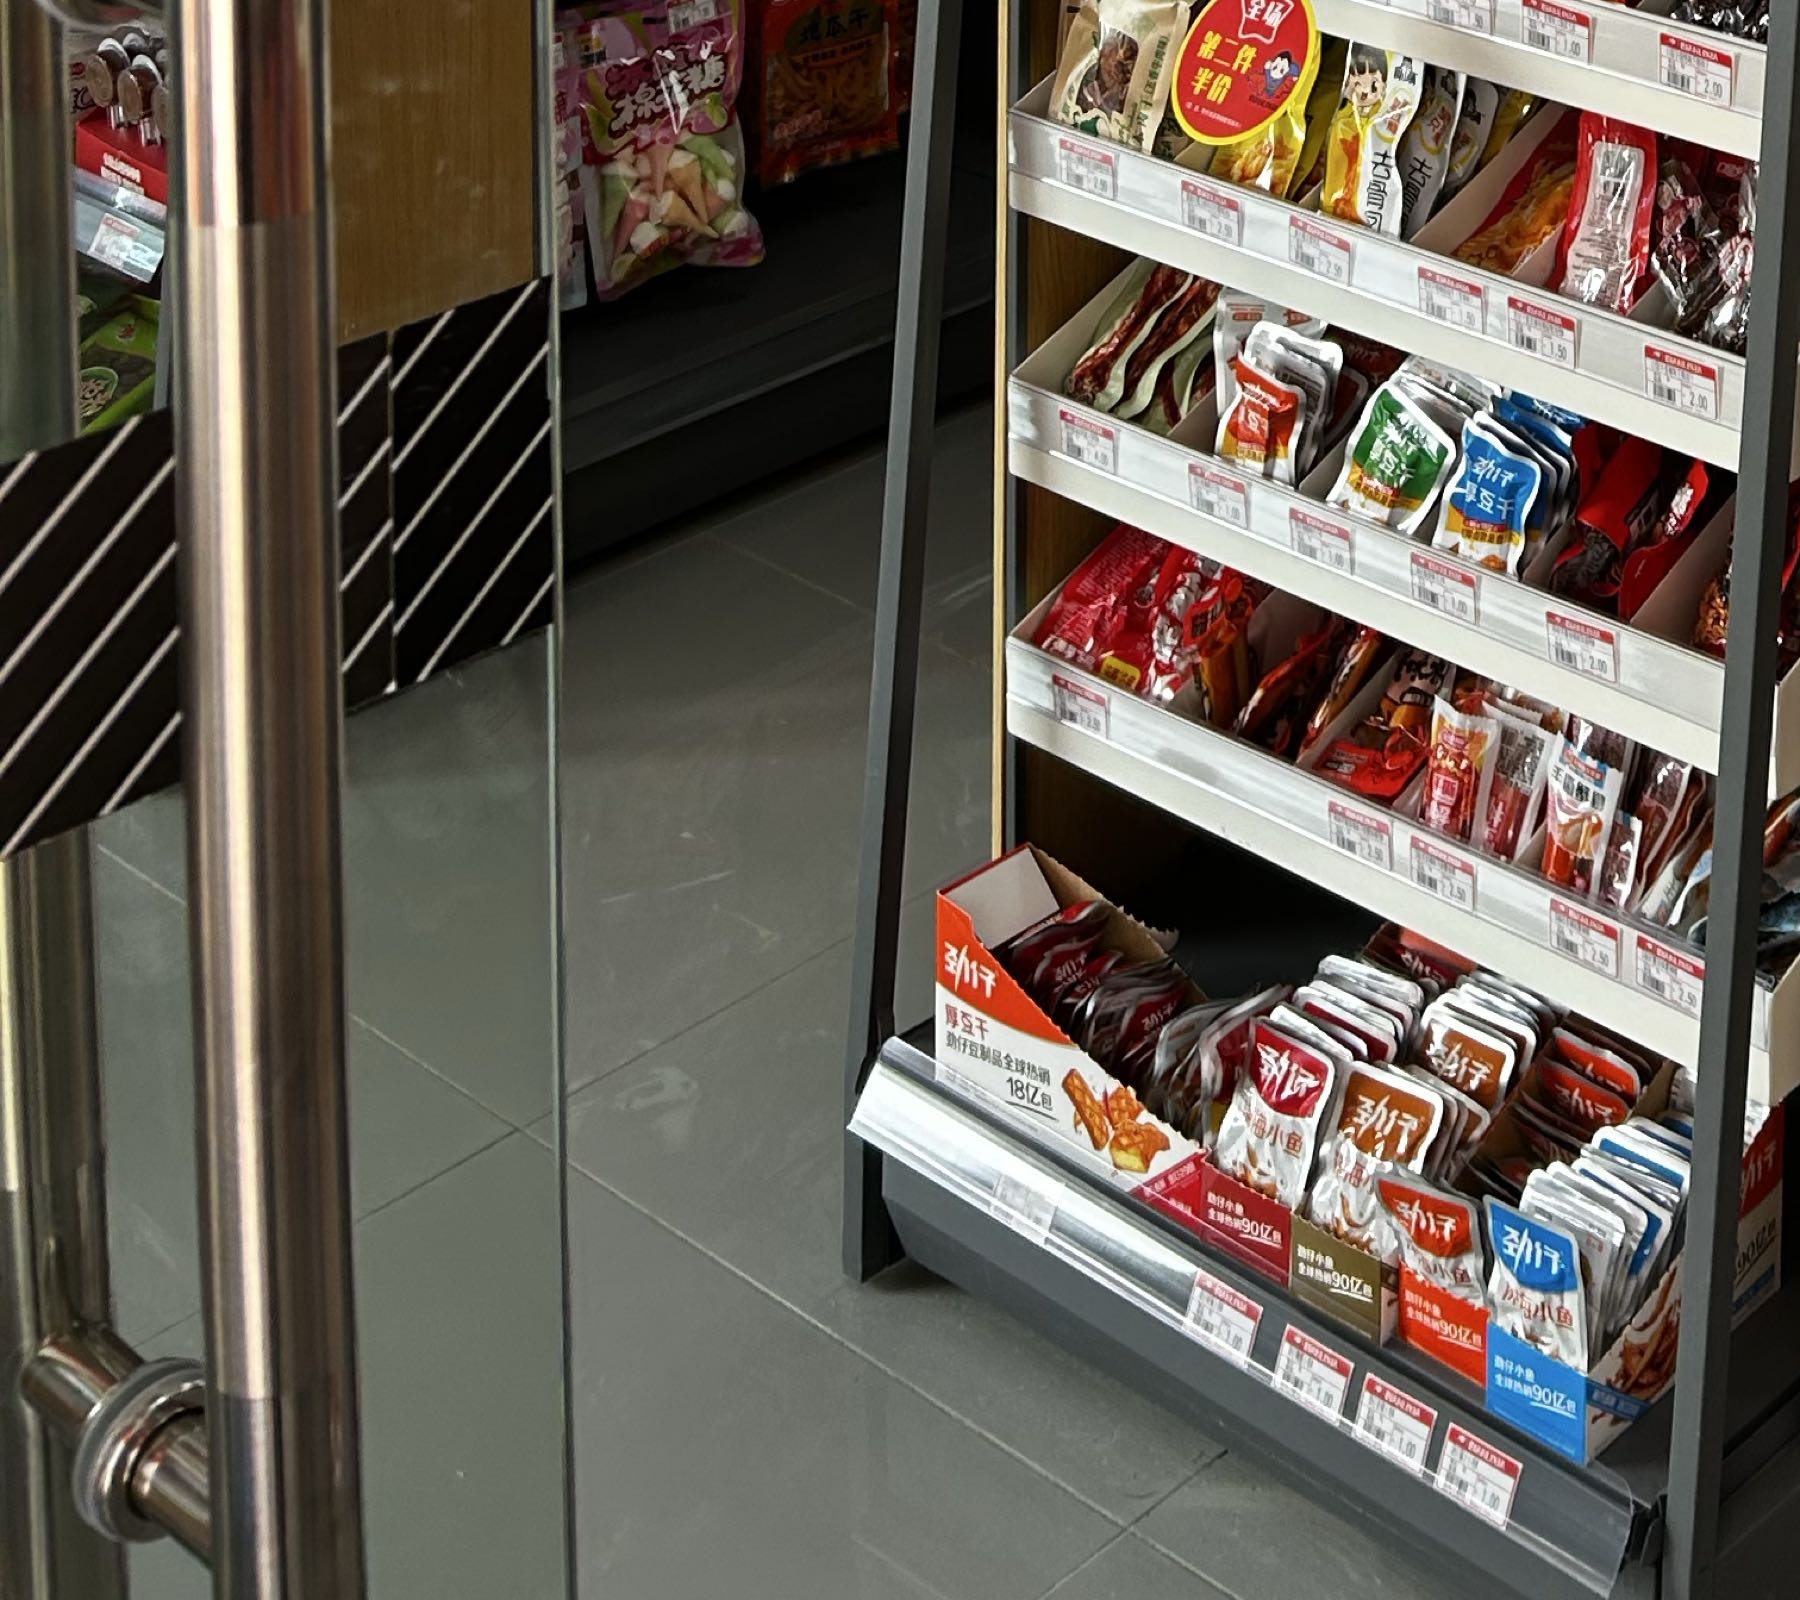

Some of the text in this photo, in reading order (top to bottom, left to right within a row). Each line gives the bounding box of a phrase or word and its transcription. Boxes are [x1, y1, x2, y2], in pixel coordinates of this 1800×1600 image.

[1196, 30, 1253, 73] 第二件
[1191, 70, 1233, 104] 半价
[943, 939, 997, 998] 劲仔
[944, 1003, 988, 1034] 厚豆干
[945, 1031, 1052, 1094] 劲仔豆制品全球热销
[1502, 1223, 1565, 1278] 劲仔
